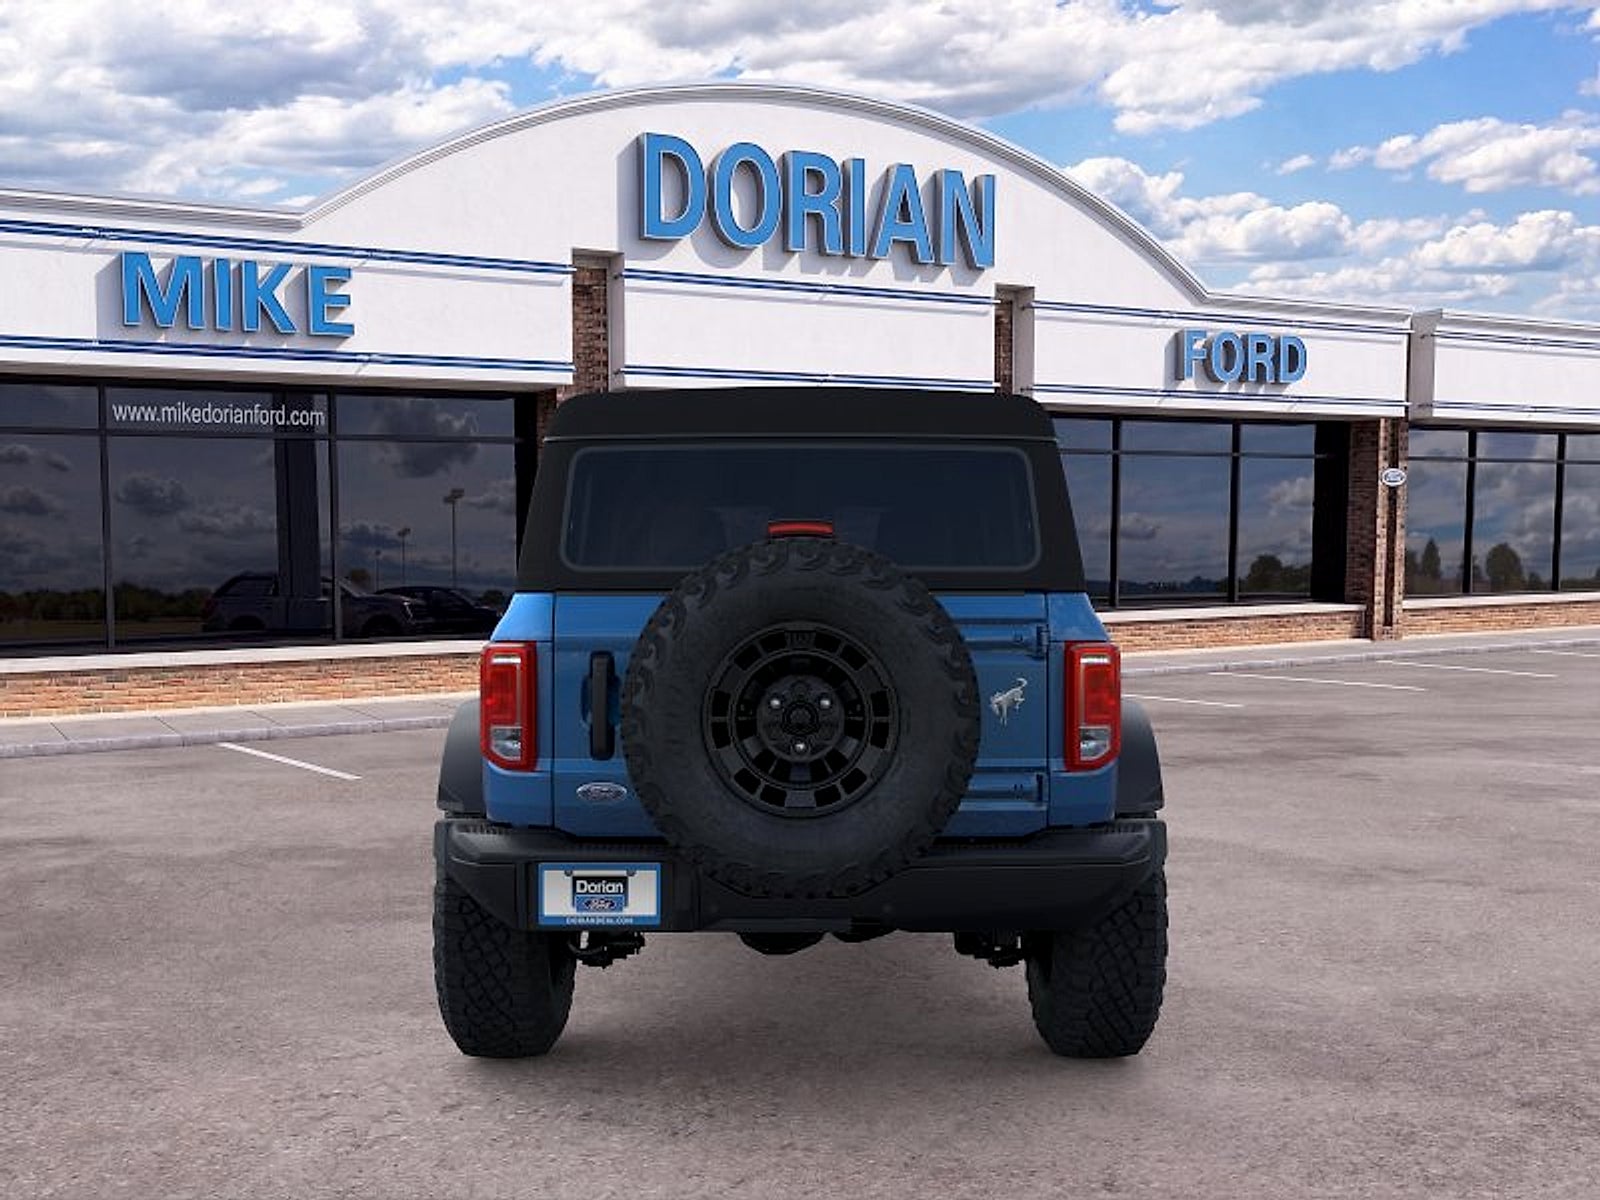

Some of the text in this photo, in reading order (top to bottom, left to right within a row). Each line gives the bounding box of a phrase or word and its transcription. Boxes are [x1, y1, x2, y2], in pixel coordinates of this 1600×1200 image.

[638, 132, 996, 269] DORIAN
[121, 250, 356, 337] MIKE
[1178, 327, 1308, 384] FORD
[111, 401, 326, 426] www.mikedorianford.com
[575, 879, 624, 894] Dorian
